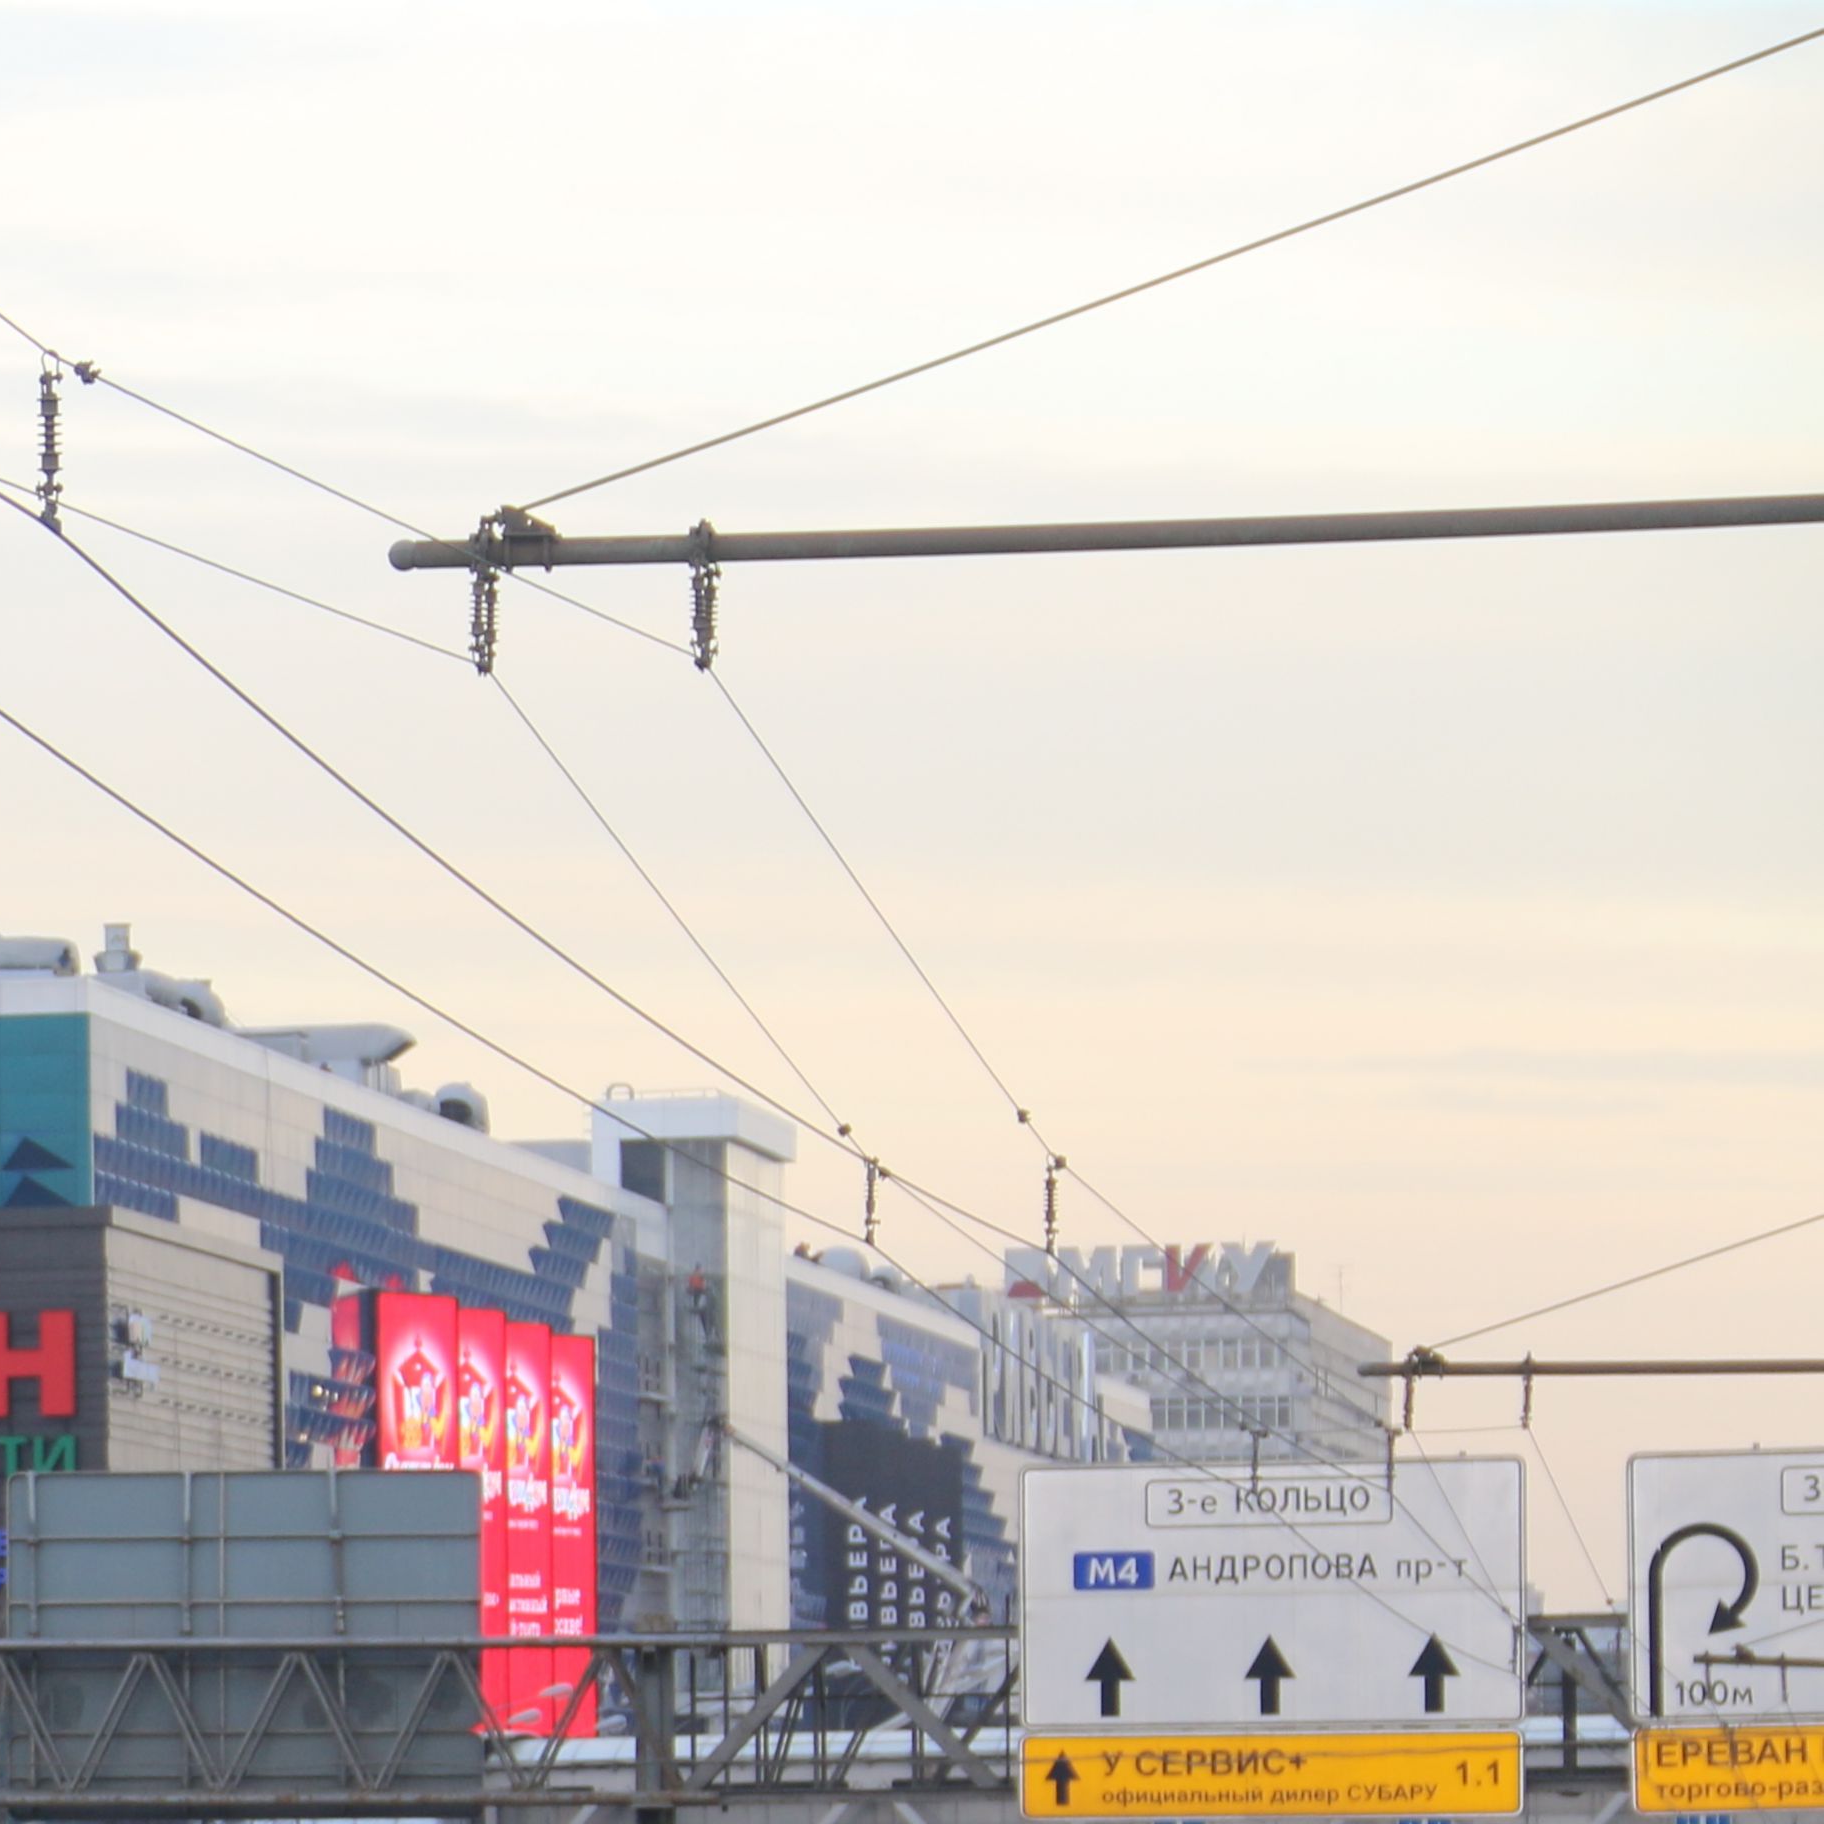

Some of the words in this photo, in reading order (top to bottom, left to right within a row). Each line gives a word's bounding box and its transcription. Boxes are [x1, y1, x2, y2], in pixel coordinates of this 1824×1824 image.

[1166, 1487, 1218, 1515] 3-е
[1234, 1484, 1372, 1515] КОЛЬЦО
[1088, 1558, 1140, 1586] М4
[1169, 1553, 1378, 1584] АНДРОПОВА
[1396, 1559, 1467, 1583] пр-т
[1676, 1680, 1753, 1707] 100м
[1134, 1748, 1307, 1777] СЕРВИС+
[1656, 1738, 1808, 1768] ЕРЕВАН
[1102, 1785, 1264, 1805] официальный
[1270, 1784, 1340, 1804] дилер
[1347, 1783, 1438, 1802] СУБАРУ
